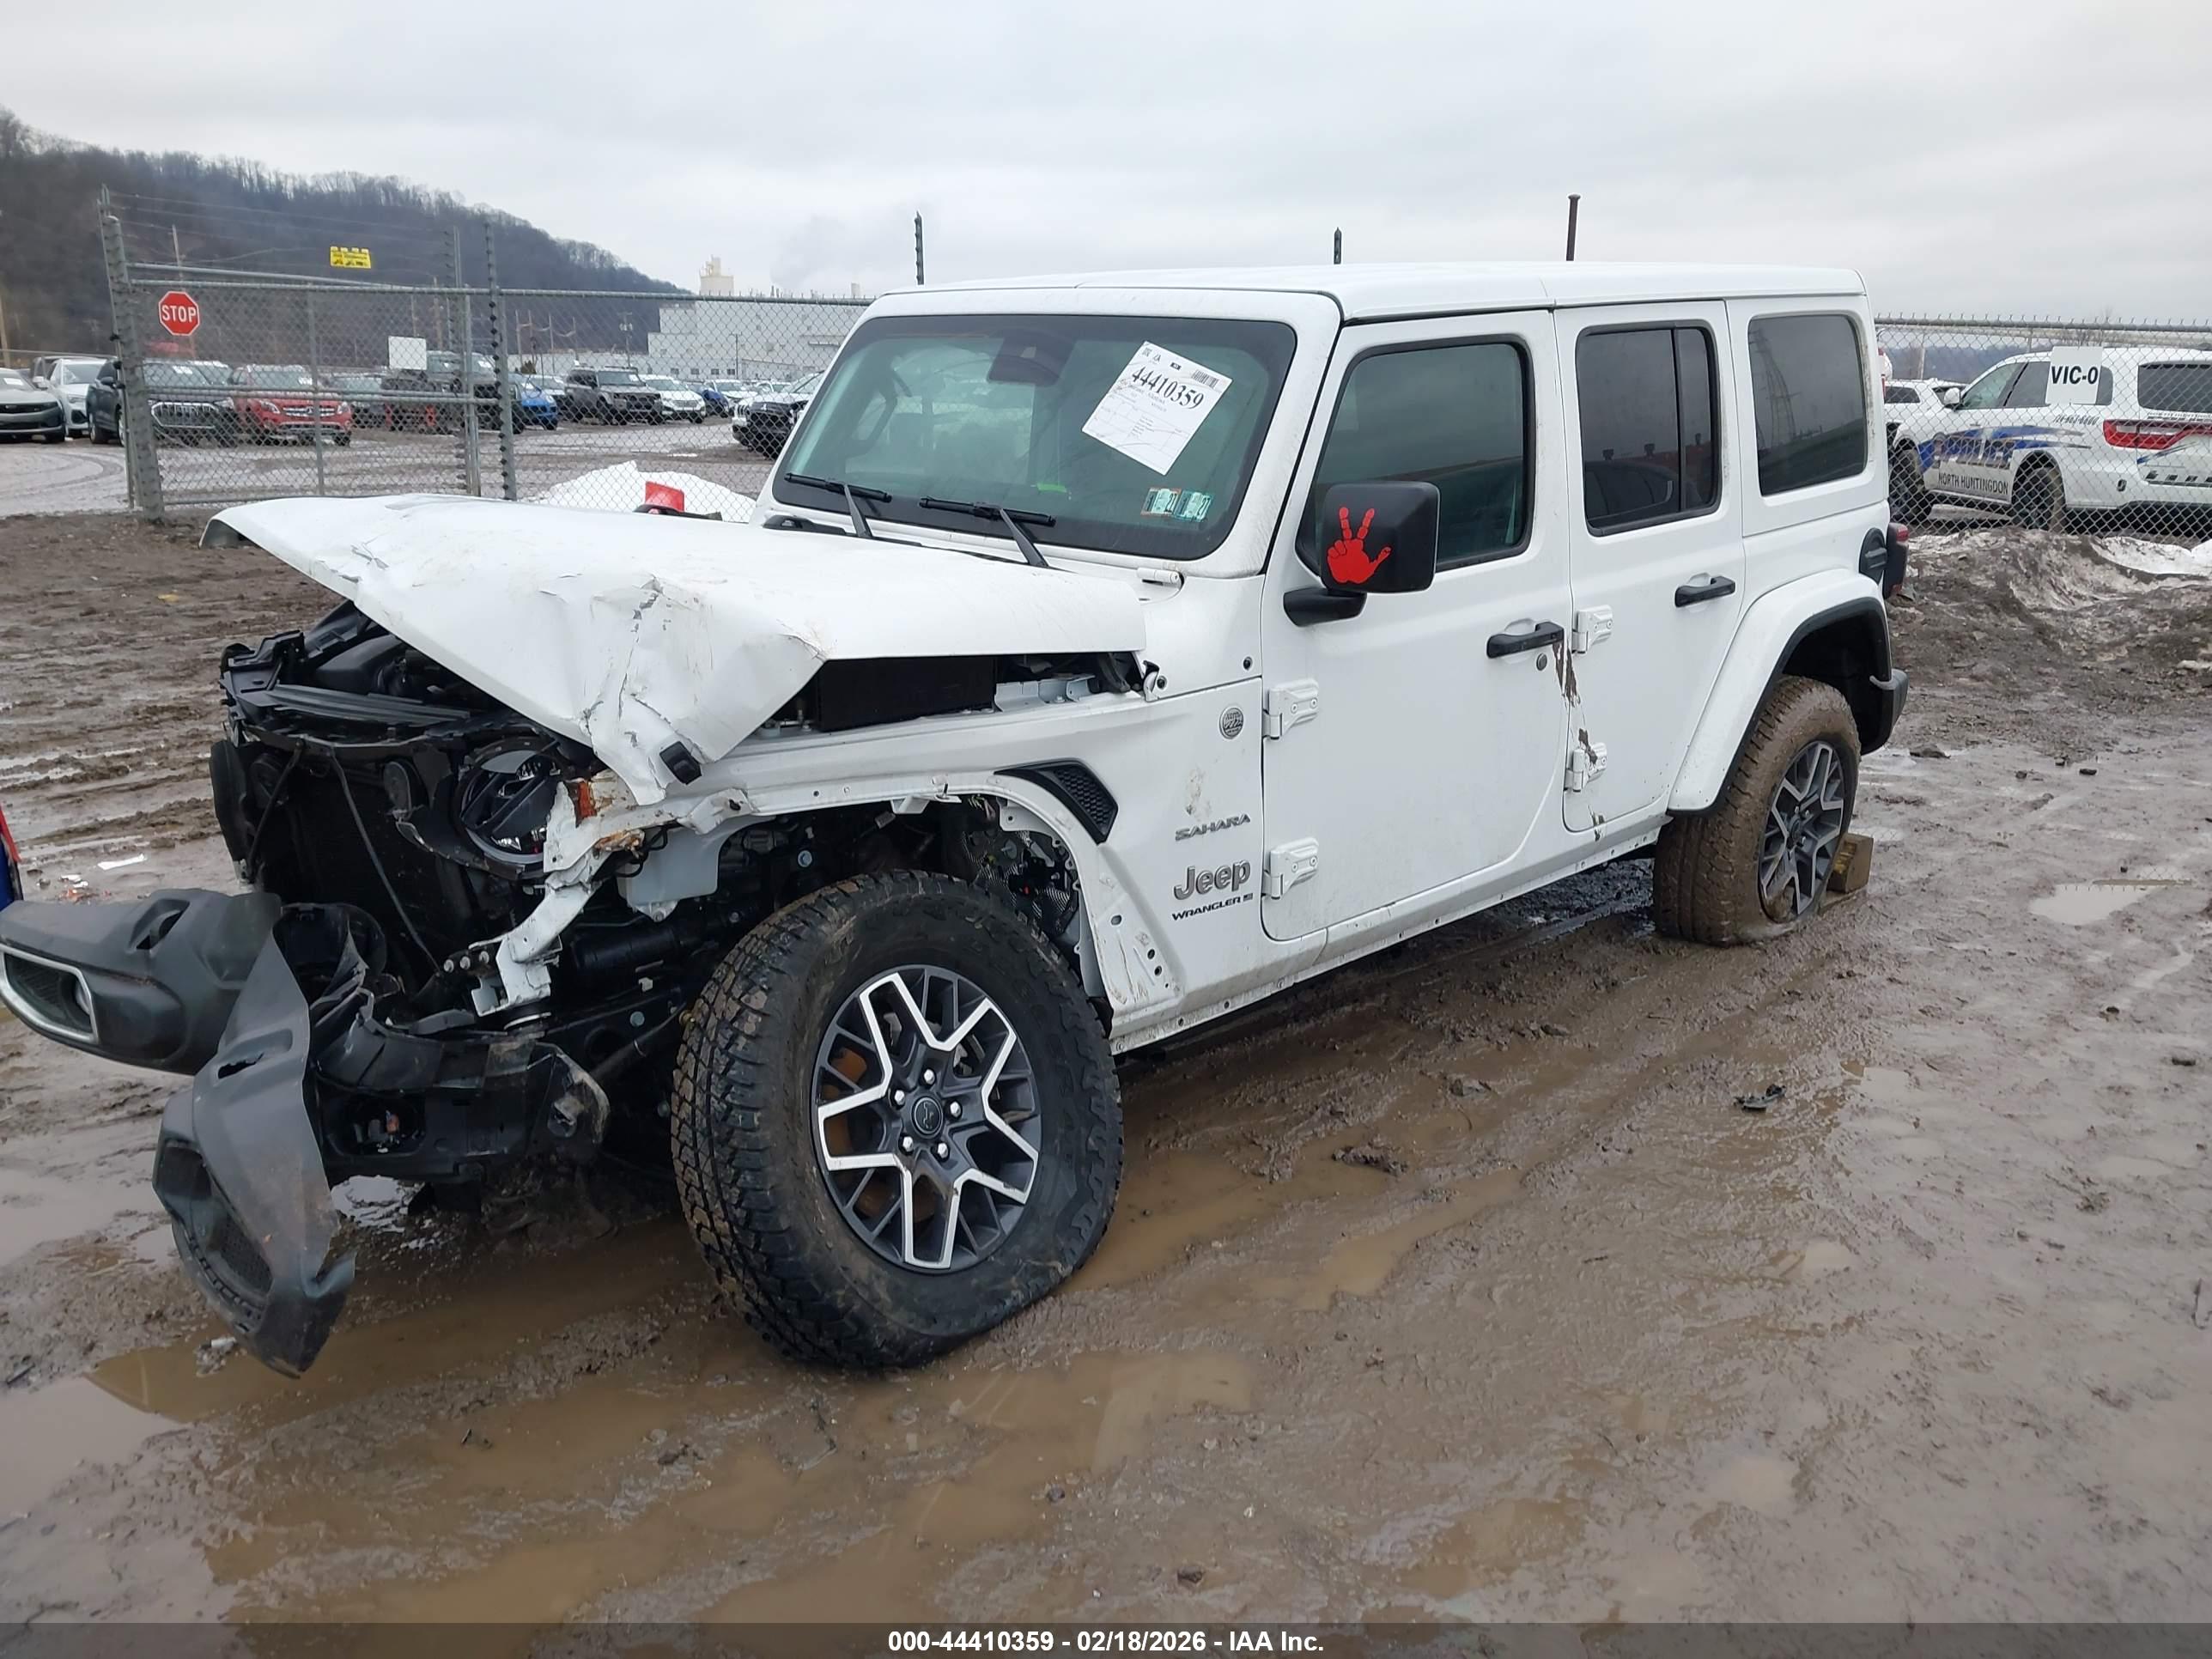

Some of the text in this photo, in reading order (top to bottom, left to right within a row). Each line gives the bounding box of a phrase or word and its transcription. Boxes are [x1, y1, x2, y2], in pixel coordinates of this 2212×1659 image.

[161, 304, 197, 323] STOP
[1131, 366, 1205, 410] 44410359
[2051, 365, 2099, 385] VIC-0
[1175, 813, 1251, 842] SAHARA
[1173, 859, 1251, 901] Jeep
[1171, 896, 1242, 921] WRANGLER
